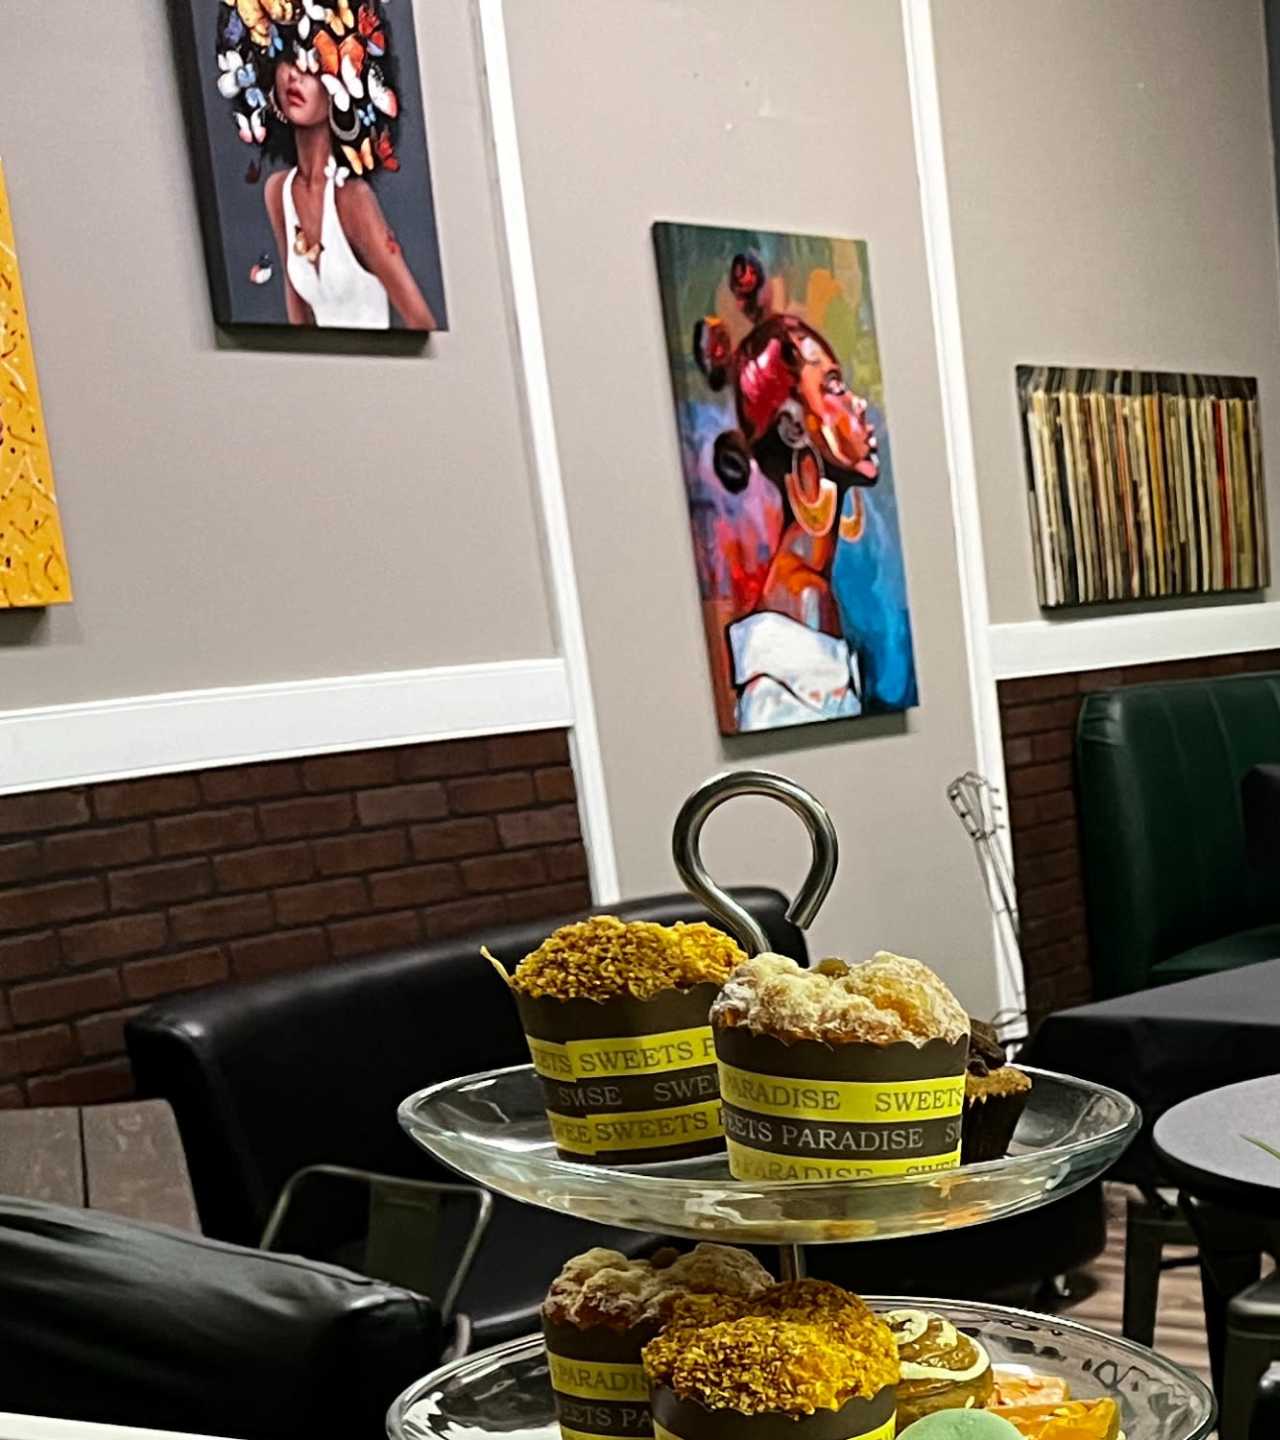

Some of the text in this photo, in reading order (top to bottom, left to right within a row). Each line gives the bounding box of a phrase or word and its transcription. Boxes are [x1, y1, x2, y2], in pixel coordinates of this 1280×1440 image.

[579, 1041, 694, 1073] SWEETS
[594, 1111, 709, 1142] SWEETS
[782, 1125, 923, 1151] PARADISE
